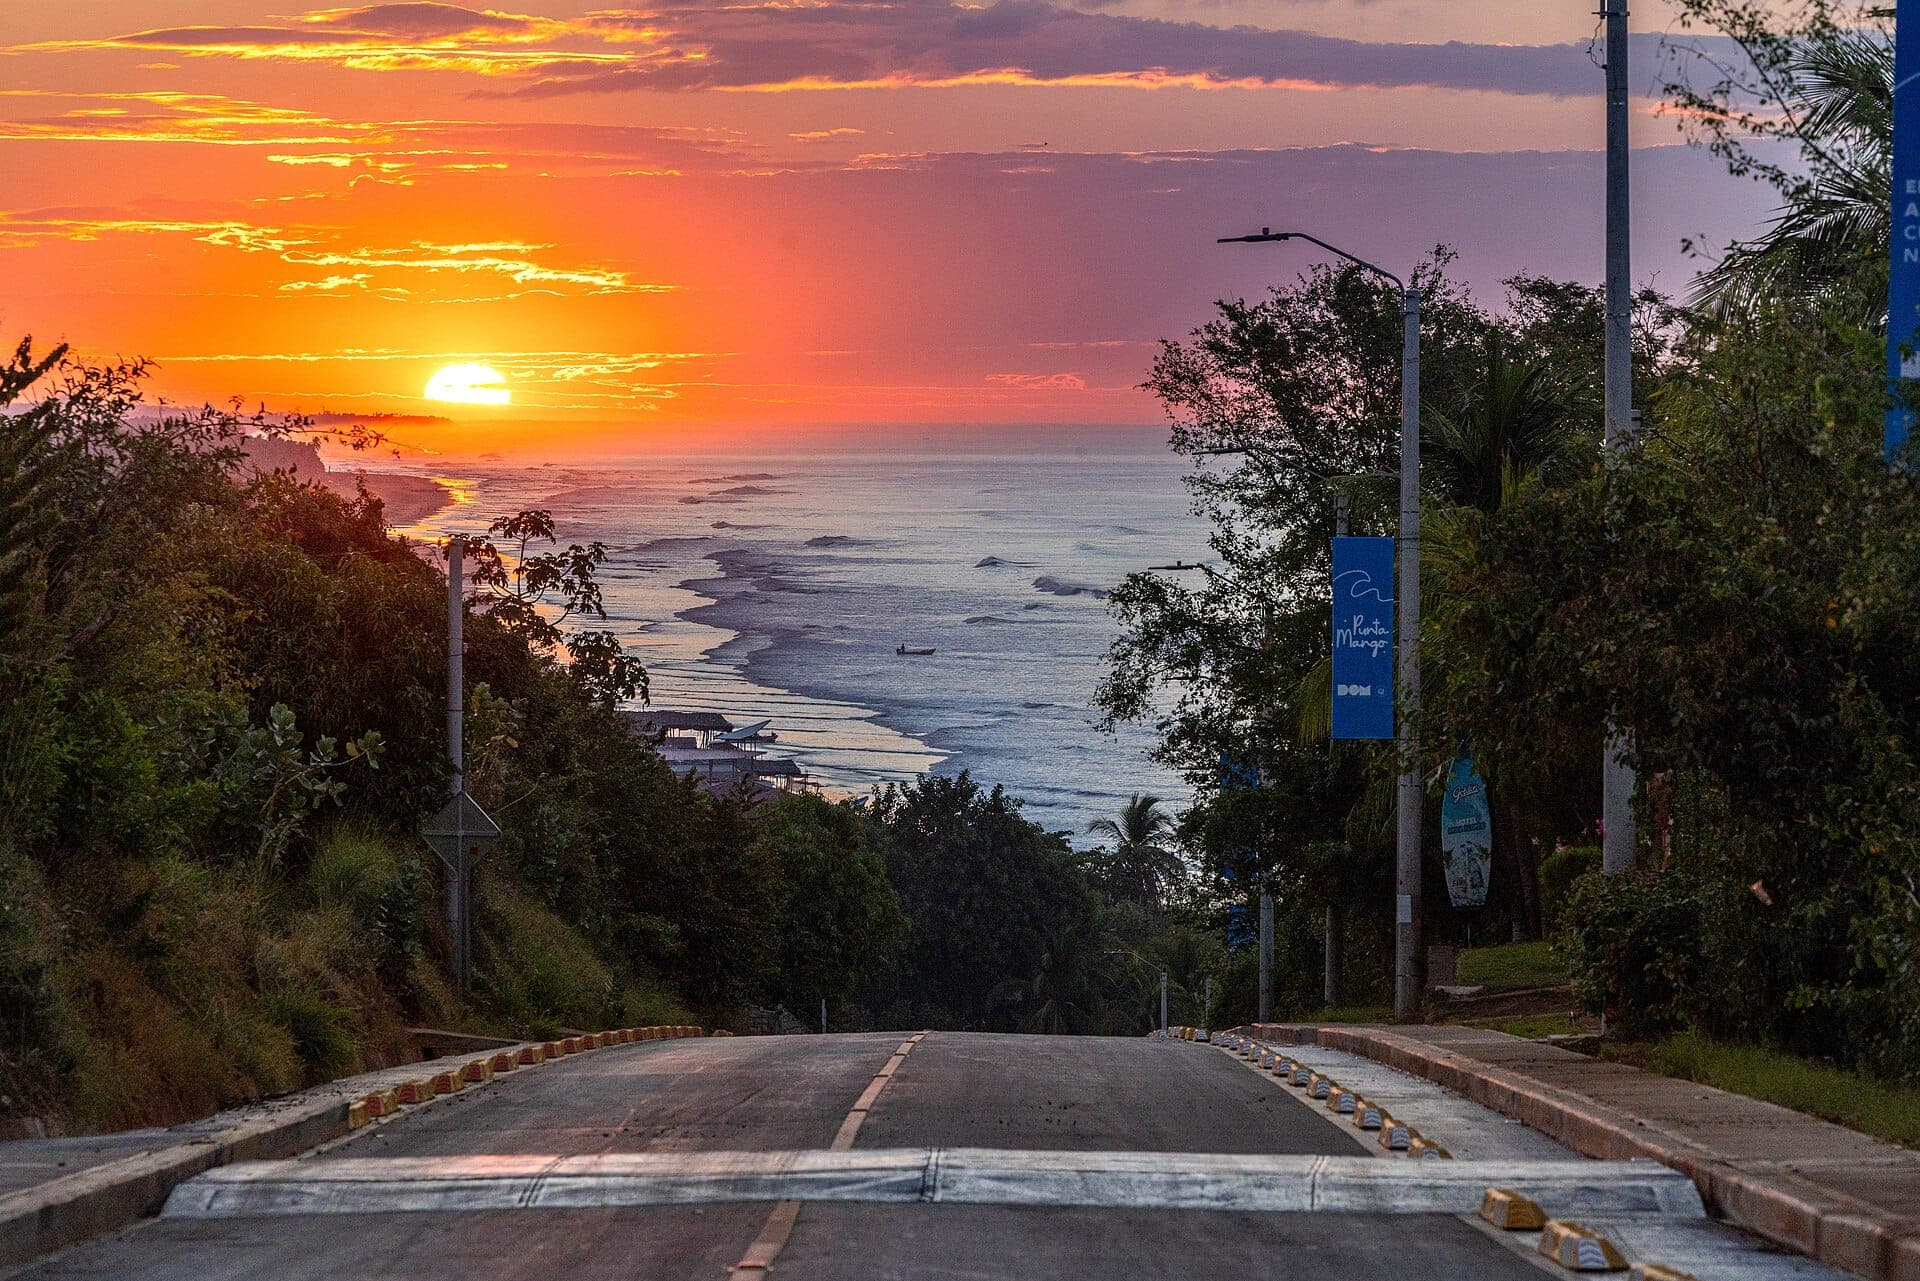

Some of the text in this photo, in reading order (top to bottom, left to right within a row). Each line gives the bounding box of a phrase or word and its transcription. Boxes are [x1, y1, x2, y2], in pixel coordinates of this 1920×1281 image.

[1906, 179, 1920, 194] E
[1904, 224, 1920, 240] C
[1353, 614, 1389, 636] Punta
[1336, 628, 1388, 657] Mango
